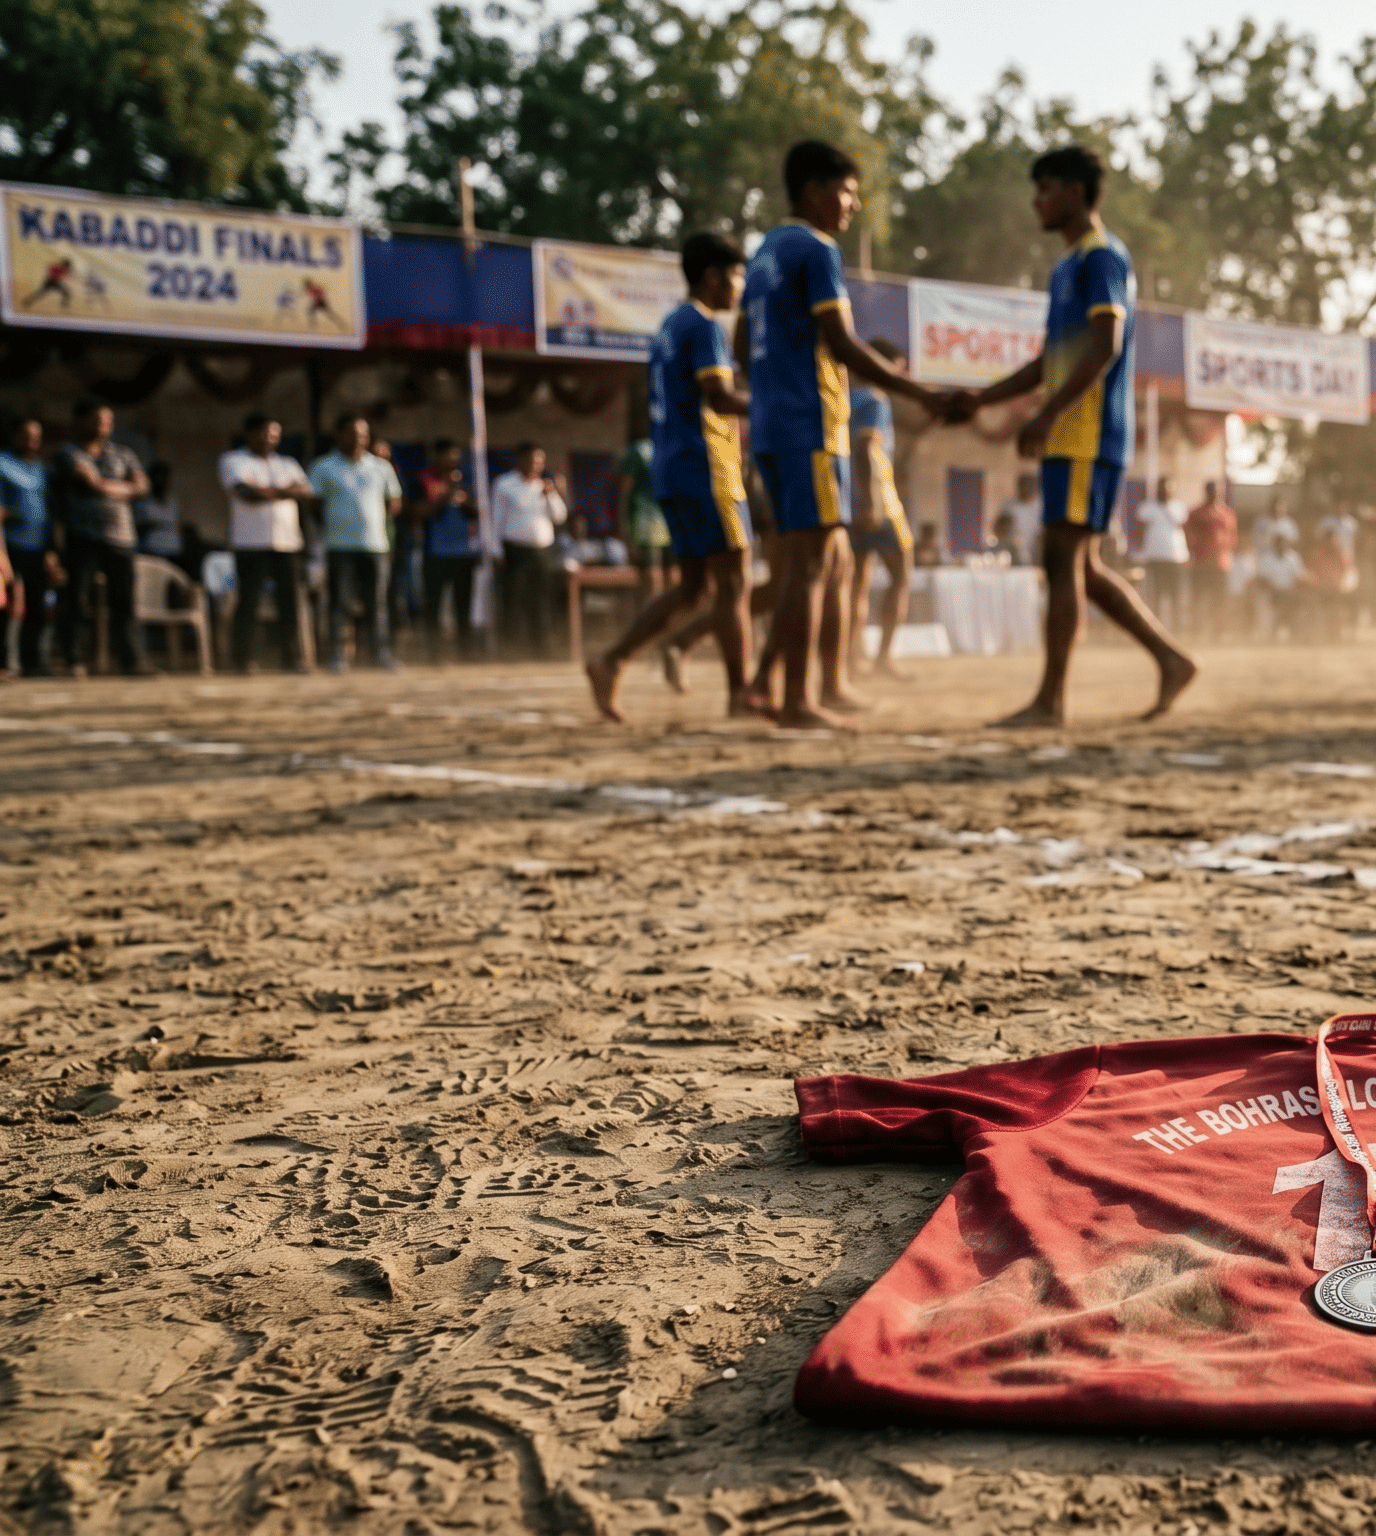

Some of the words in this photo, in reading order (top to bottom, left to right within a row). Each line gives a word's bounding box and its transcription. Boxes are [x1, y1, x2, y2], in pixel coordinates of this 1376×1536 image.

[18, 203, 201, 257] KABADDI
[213, 224, 344, 270] FINALS
[146, 261, 238, 302] 2024
[1199, 348, 1302, 394] SPORTS
[1132, 1117, 1209, 1155] THE
[1196, 1086, 1322, 1136] BOHRAS
